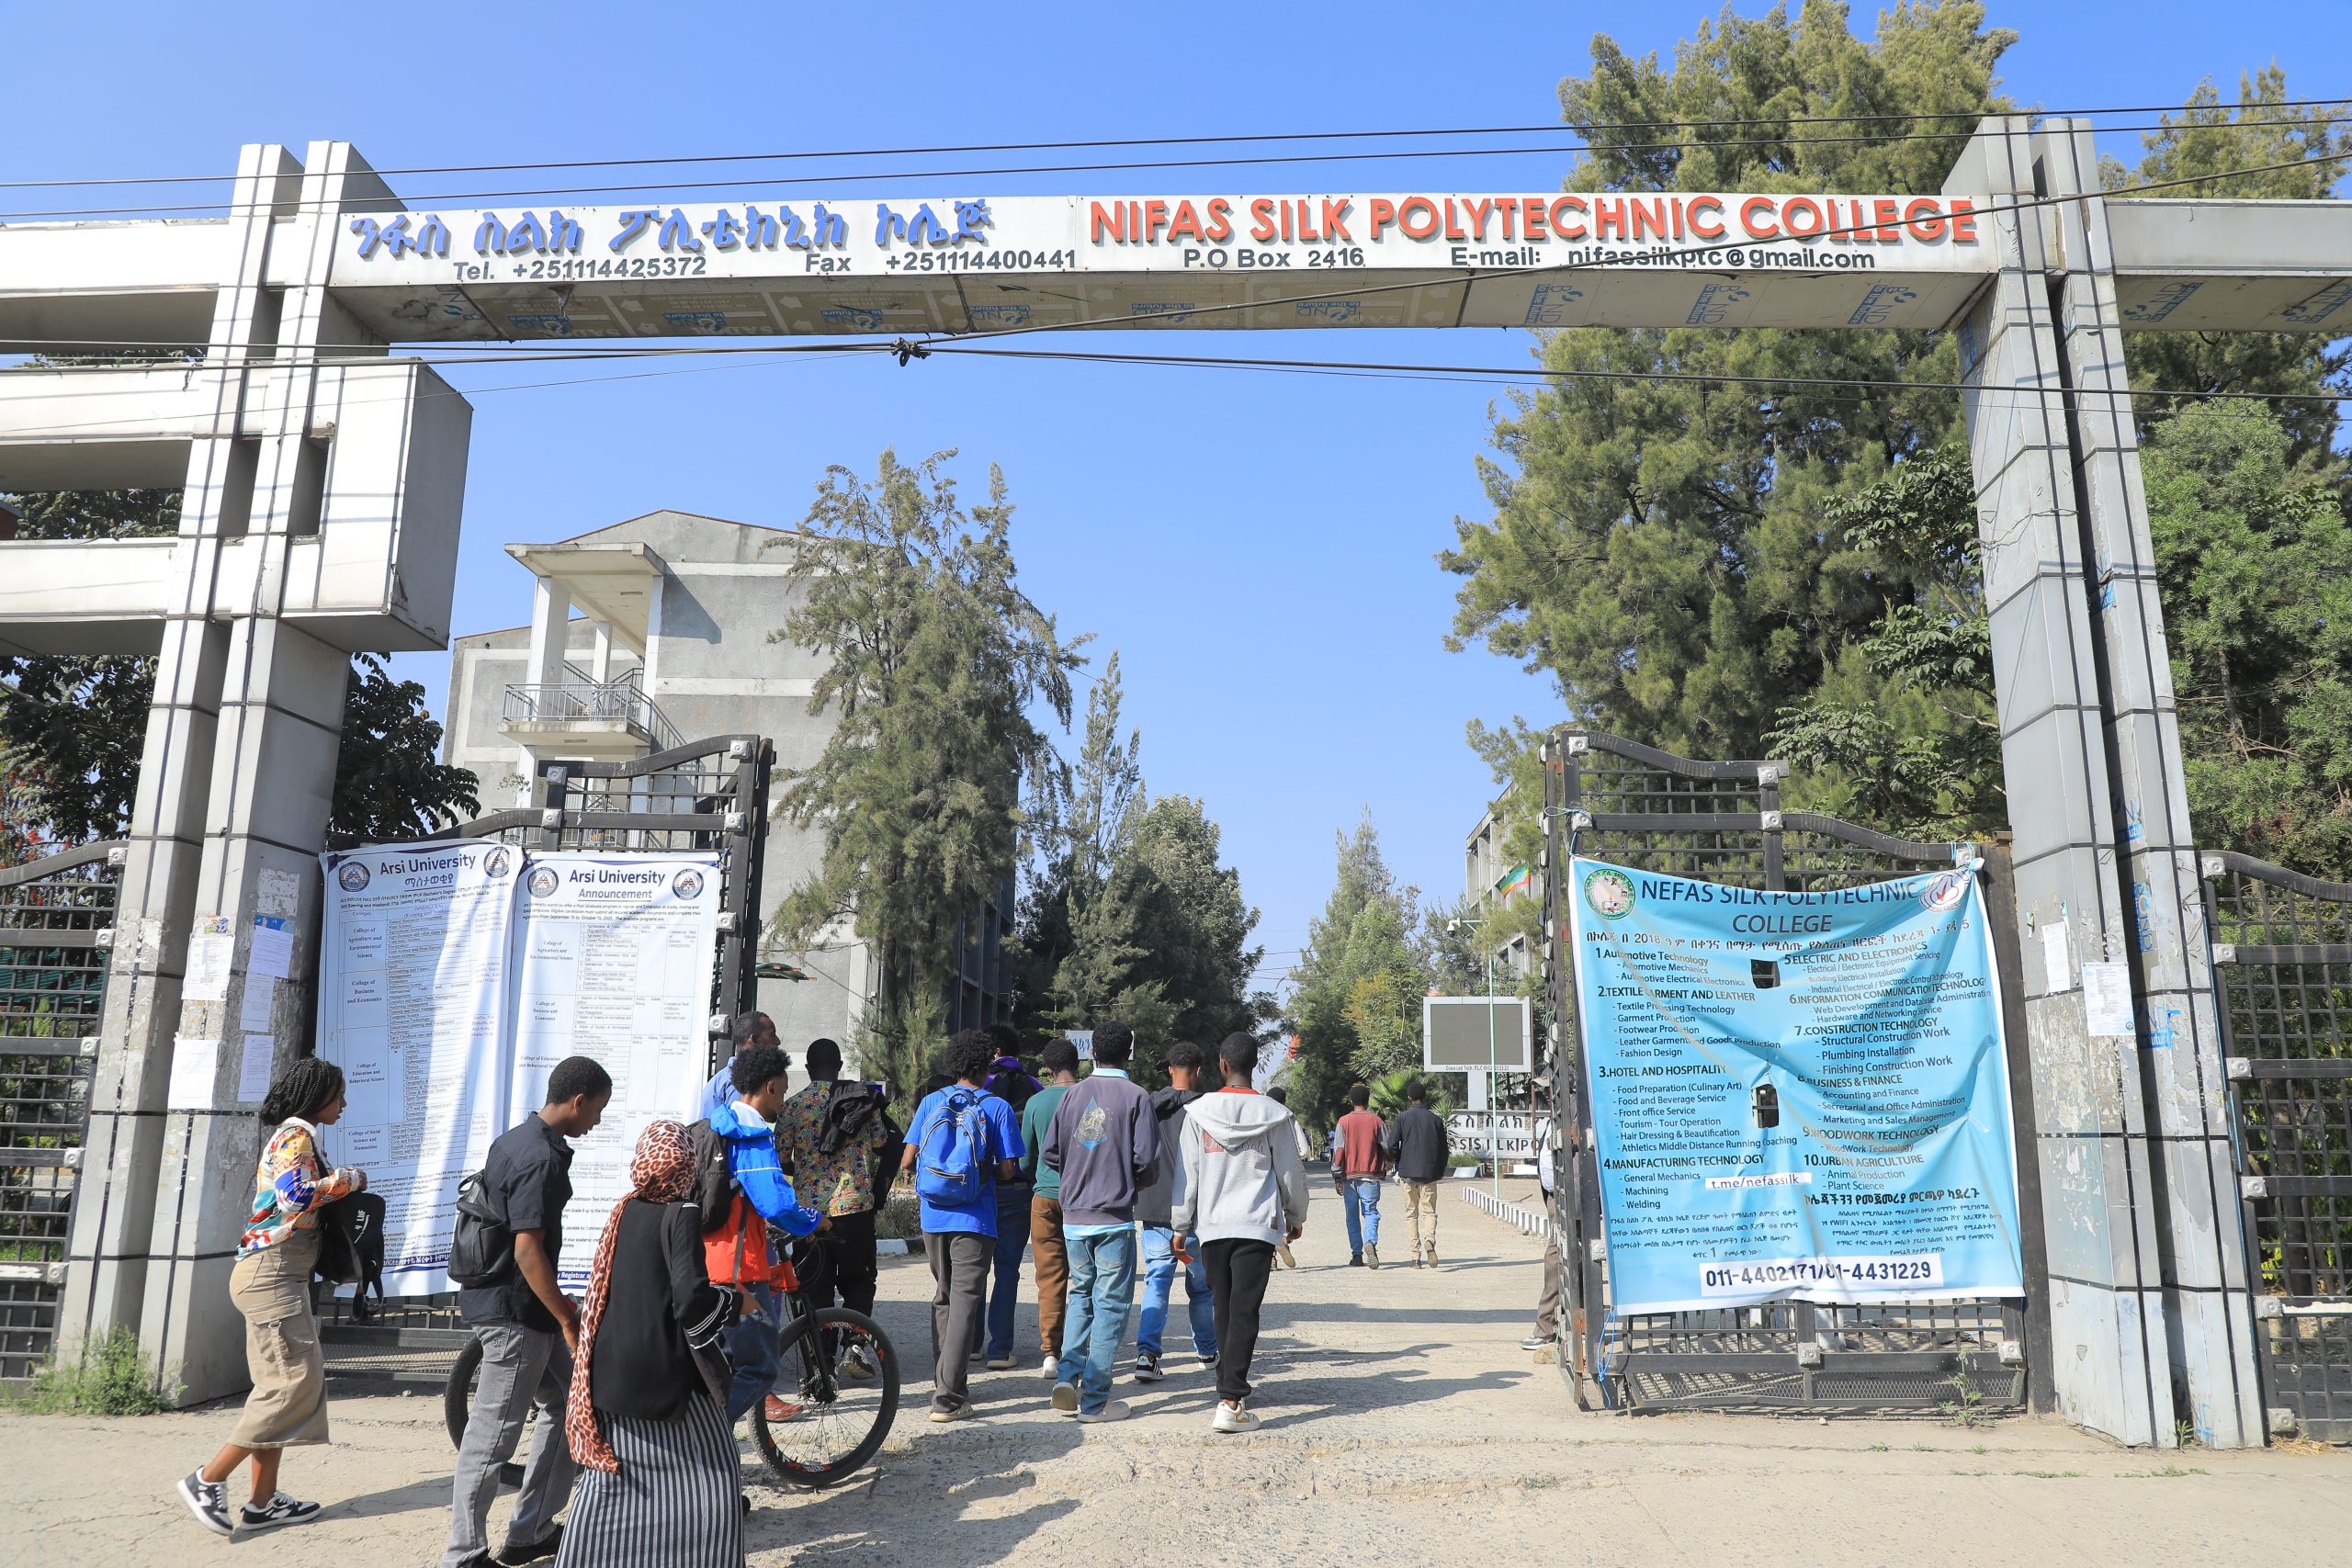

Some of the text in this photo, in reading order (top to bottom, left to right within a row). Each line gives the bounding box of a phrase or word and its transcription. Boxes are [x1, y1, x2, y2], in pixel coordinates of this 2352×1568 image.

[1091, 195, 1976, 243] NIFAS SILK POLYTECHNIC COLLEGE
[350, 214, 448, 258] ንፋስ
[474, 209, 581, 255] ስልክ
[608, 203, 845, 251] ፖሊቴክኒክ
[806, 250, 1076, 272] Fax +251114400441
[1183, 247, 1364, 268] P.O Box 2416
[1451, 246, 1541, 266] E-mail:
[453, 256, 707, 280] Tel. +251114425372
[380, 855, 476, 874] Arsi University
[404, 874, 453, 887] ማስታወቂያ
[570, 870, 665, 886] Arsi University
[579, 889, 652, 898] Announcement
[1641, 880, 1714, 904] NEFAS
[1720, 885, 1767, 905] SILK
[1773, 882, 1920, 906] POLYTECHNIC
[1732, 914, 1834, 934] COLLEGE
[1634, 933, 1661, 944] 2018
[1658, 952, 1708, 965] Technology
[1838, 942, 1928, 963] AND ELECTRONICS
[1668, 964, 1708, 975] Mechanics
[1807, 954, 1914, 974] Electrical Electronic Equipment
[1667, 975, 1745, 987] Electrical Electronics
[1808, 966, 1906, 984] Building Electrical Installation
[1812, 985, 1842, 993] Industrial
[1843, 982, 1873, 992] Electrical
[1879, 977, 1909, 987] Electronic
[1931, 977, 1986, 991] TECHNOLOGY
[1691, 990, 1713, 999] AND
[1715, 991, 1755, 1001] LEATHER
[1617, 1002, 1736, 1015] Textile Technology
[1814, 1007, 1833, 1015] Web
[1835, 1001, 1889, 1014] Development
[1618, 1014, 1654, 1022] Garment
[1817, 1009, 1917, 1023] Hardware and Networking
[1880, 1017, 1939, 1032] TECHNOLOGY
[1620, 1036, 1781, 1048] Leather Goods Production
[1822, 1027, 1951, 1046] Structural Construction Work
[1621, 1049, 1682, 1057] Fashion Design
[1822, 1045, 1915, 1061] Plumbing Installation
[1599, 1065, 1726, 1077] 3.HOTEL AND HOSPITALITY
[1823, 1055, 1952, 1075] Finishing Construction Work
[1854, 1074, 1903, 1087] & FINANCE
[1617, 1081, 1742, 1094] Food Preparation (Culinary Art)
[1822, 1088, 1919, 1100] Accounting and Finance
[1618, 1094, 1726, 1105] Food and Beverage Service
[1822, 1096, 1965, 1111] Secretarial and Office Administration
[1619, 1107, 1695, 1117] Front office Service
[1823, 1115, 1866, 1126] Marketing
[1884, 1116, 1907, 1124] Sales
[1908, 1111, 1955, 1124] Management
[1620, 1118, 1721, 1129] Tourism Tour Operation
[1621, 1132, 1637, 1140] Hair
[1639, 1131, 1674, 1141] Dressing
[1684, 1128, 1740, 1138] Beautification
[1876, 1124, 1939, 1140] TECHNOLOGY
[1623, 1136, 1797, 1152] Athletics Middle Distance Running Coaching
[1868, 1144, 1914, 1154] Technology
[1698, 1154, 1765, 1166] TECHNOLOGY
[1804, 1154, 1925, 1167] 10.URBAN AGRICULTURE
[1624, 1171, 1701, 1182] General Mechanics
[1827, 1169, 1905, 1179] Animal Production
[1711, 1175, 1799, 1190] t.me/nefassilk
[1827, 1180, 1884, 1190] Plant Science
[1625, 1187, 1668, 1196] Machining
[1626, 1200, 1661, 1210] Welding
